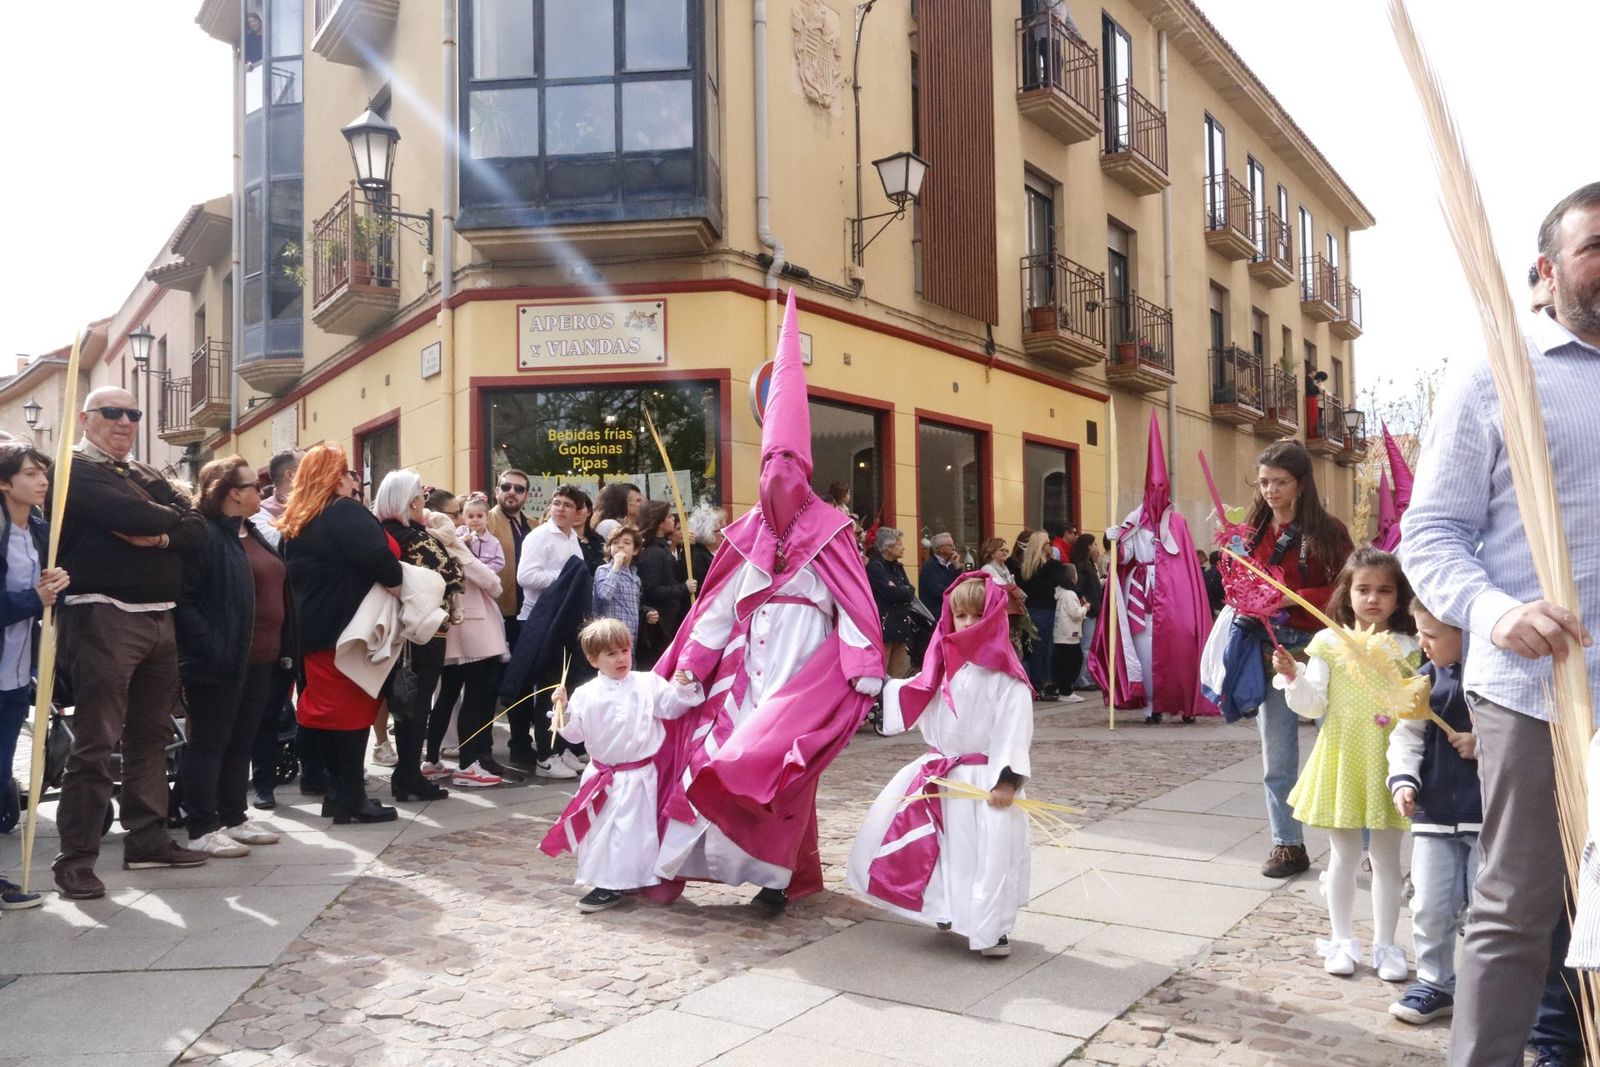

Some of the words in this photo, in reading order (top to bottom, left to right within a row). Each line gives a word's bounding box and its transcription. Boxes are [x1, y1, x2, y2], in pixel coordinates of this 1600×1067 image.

[530, 313, 614, 331] APEROS
[546, 337, 640, 356] VIANDAS
[548, 429, 600, 441] Bebidas
[604, 428, 633, 440] frías
[558, 443, 623, 455] Golosinas
[573, 457, 608, 471] Pipas
